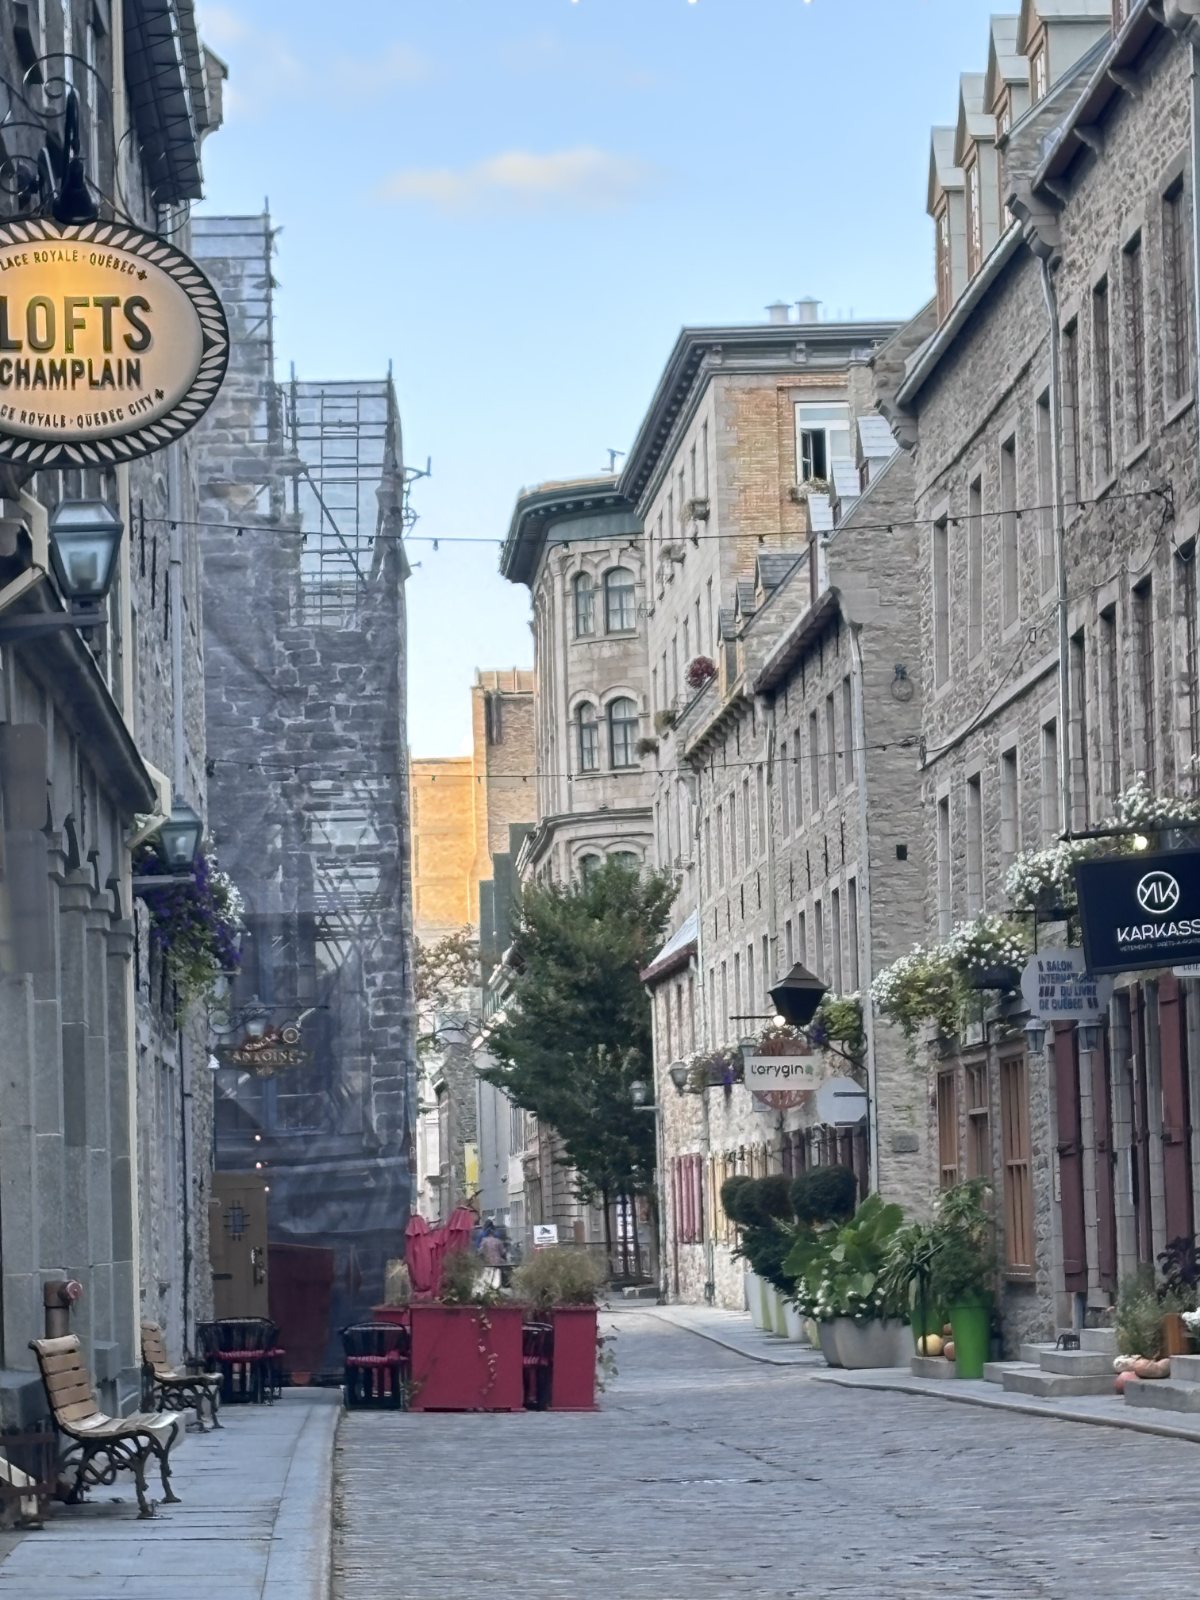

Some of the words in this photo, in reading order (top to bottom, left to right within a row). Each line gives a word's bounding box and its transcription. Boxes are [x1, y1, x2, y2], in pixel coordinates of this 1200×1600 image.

[34, 250, 78, 263] ROYALE
[0, 296, 152, 353] LOFTS
[0, 358, 142, 389] CHAMPLAIN
[20, 410, 66, 428] ROYALE
[128, 394, 154, 415] CITY
[1117, 919, 1200, 942] KARKASS
[1046, 961, 1072, 972] SALON
[1039, 973, 1098, 984] INTERNATONAL
[1061, 986, 1072, 996] DU
[1075, 985, 1096, 996] LIVRE
[1039, 999, 1049, 1010] DE
